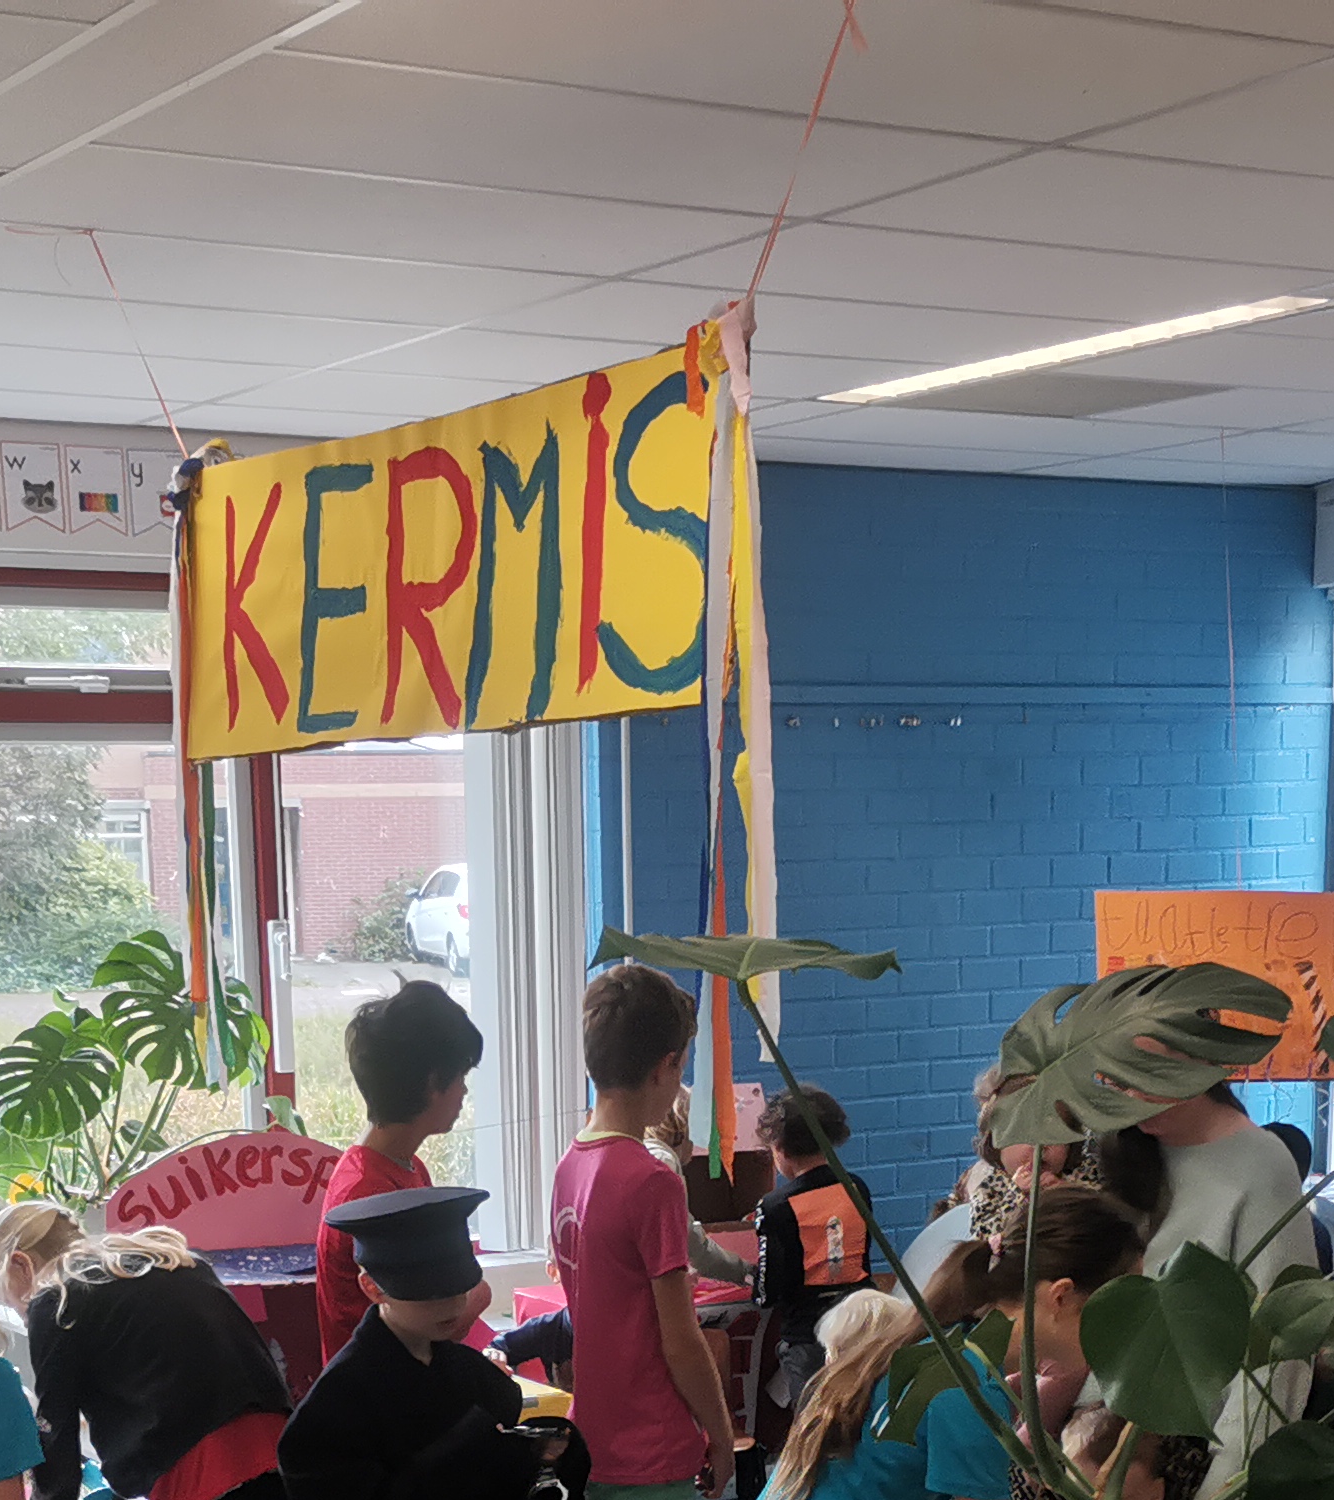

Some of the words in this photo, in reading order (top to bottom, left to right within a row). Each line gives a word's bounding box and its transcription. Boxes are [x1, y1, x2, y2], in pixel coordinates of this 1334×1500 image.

[4, 453, 26, 471] w
[70, 457, 81, 474] x
[130, 461, 144, 487] y
[223, 371, 707, 734] KERMIS
